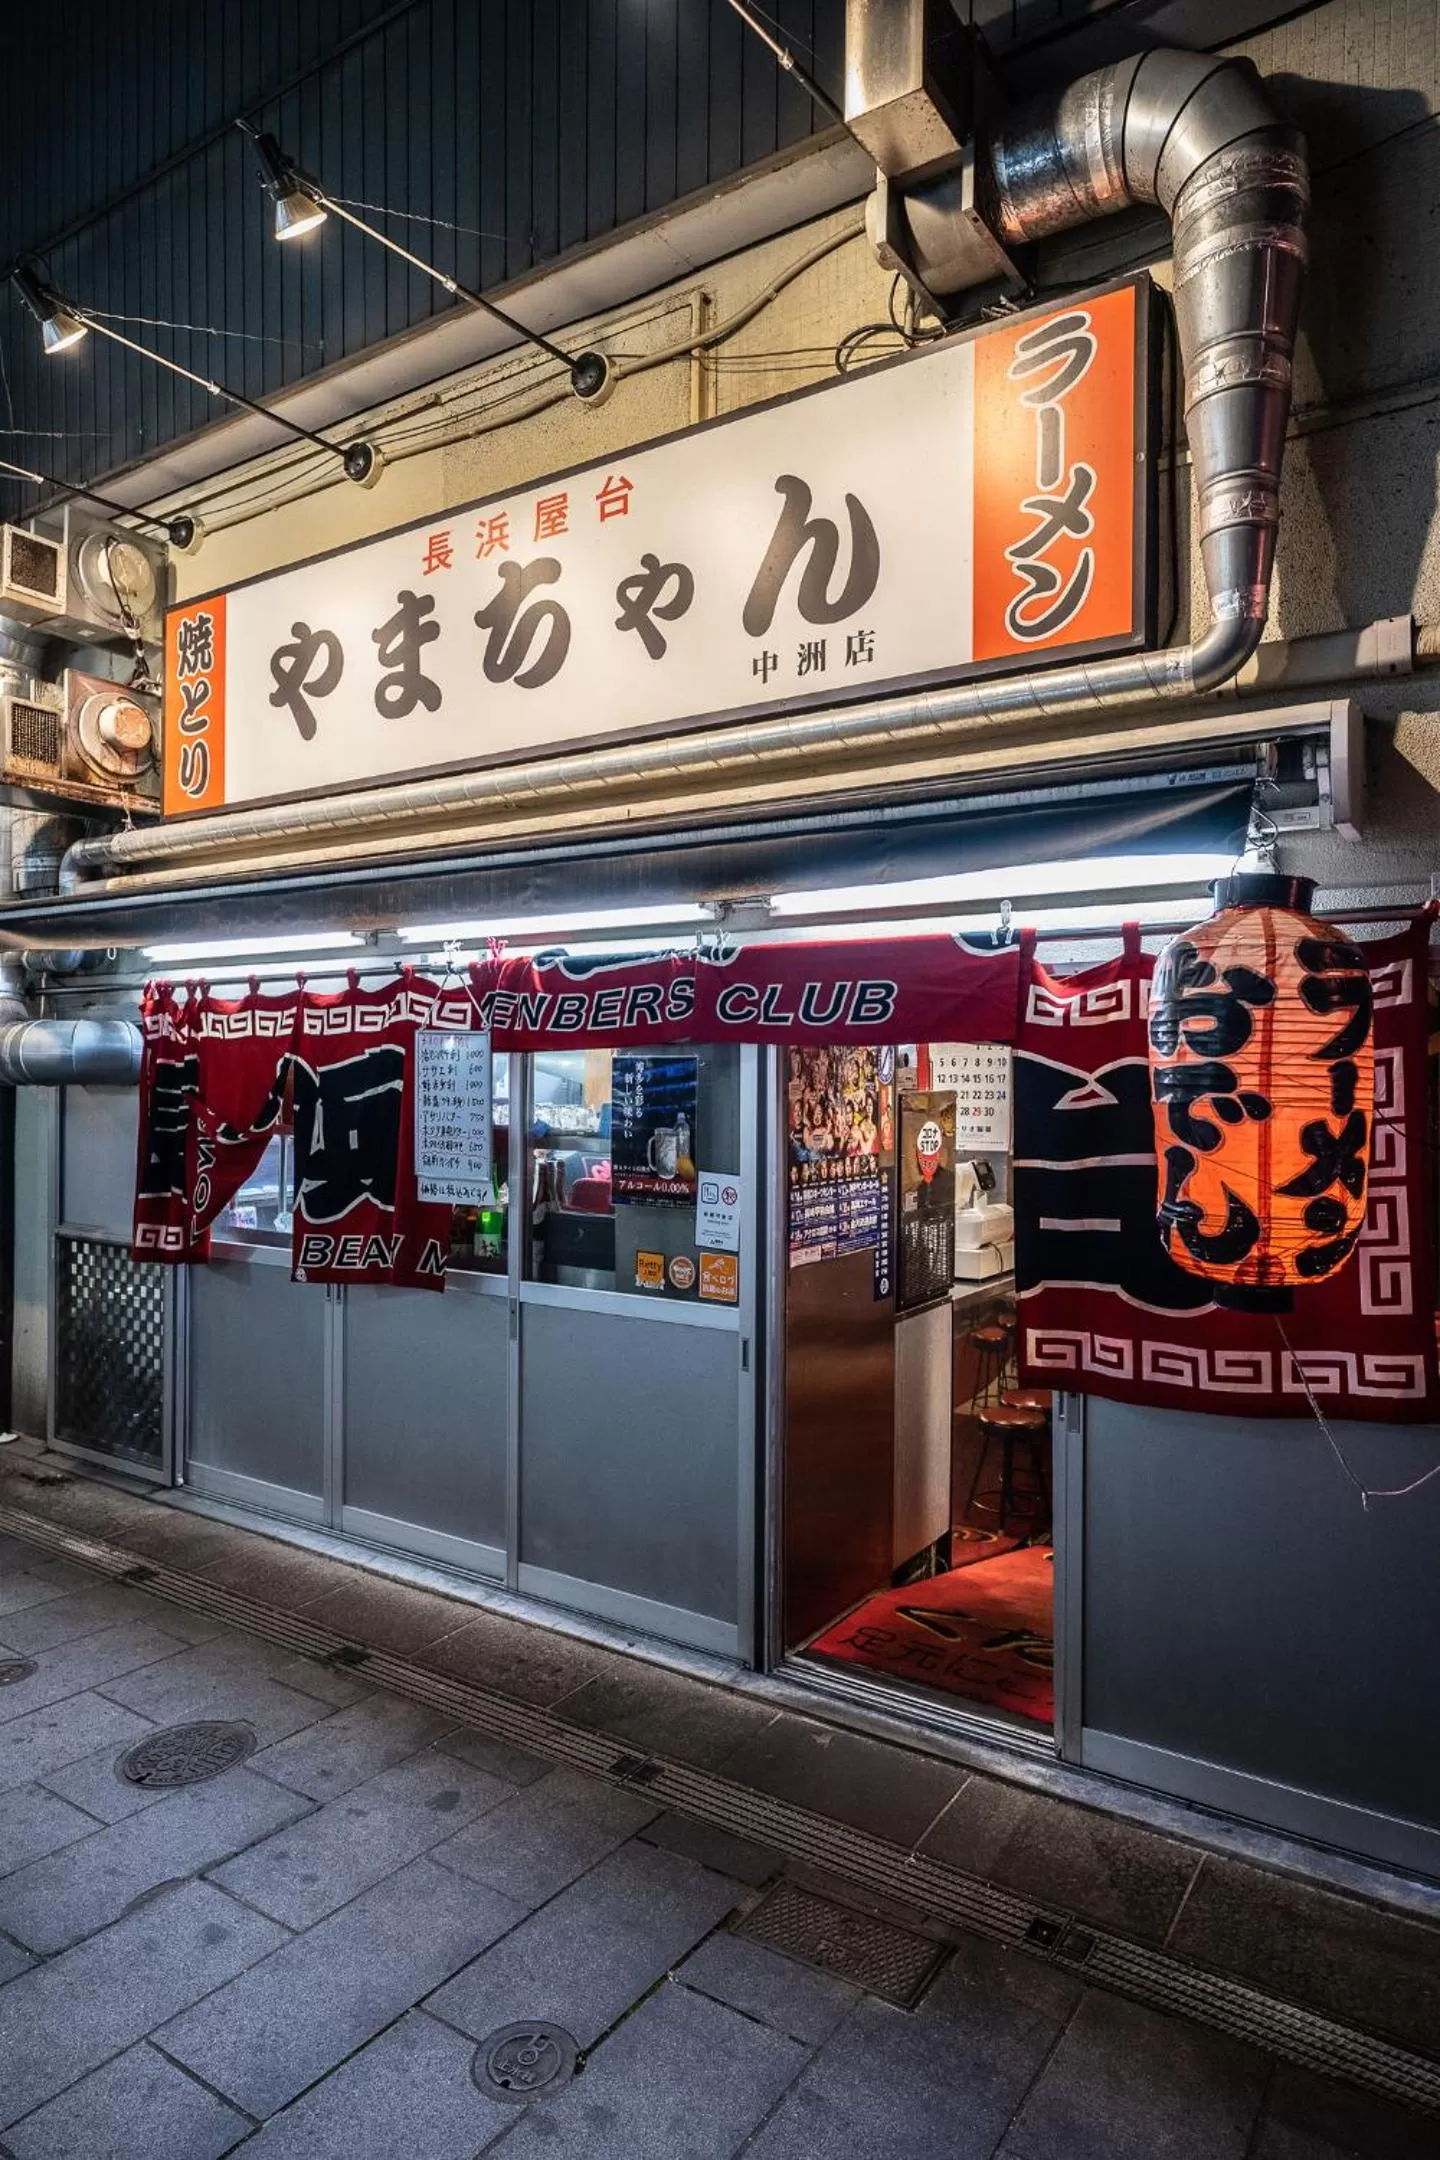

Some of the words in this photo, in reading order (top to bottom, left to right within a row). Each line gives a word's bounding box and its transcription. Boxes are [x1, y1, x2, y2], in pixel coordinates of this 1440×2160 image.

[421, 475, 634, 576] 長浜屋台
[1004, 310, 1098, 642] ラーメン
[268, 473, 881, 741] やまちゃん
[751, 629, 876, 684] 中洲店
[175, 611, 214, 798] 焼とり
[716, 978, 898, 1026] CLUB
[920, 1140, 940, 1152] STOP
[922, 1128, 938, 1139] コロナ
[1273, 937, 1373, 1278] ラーメン
